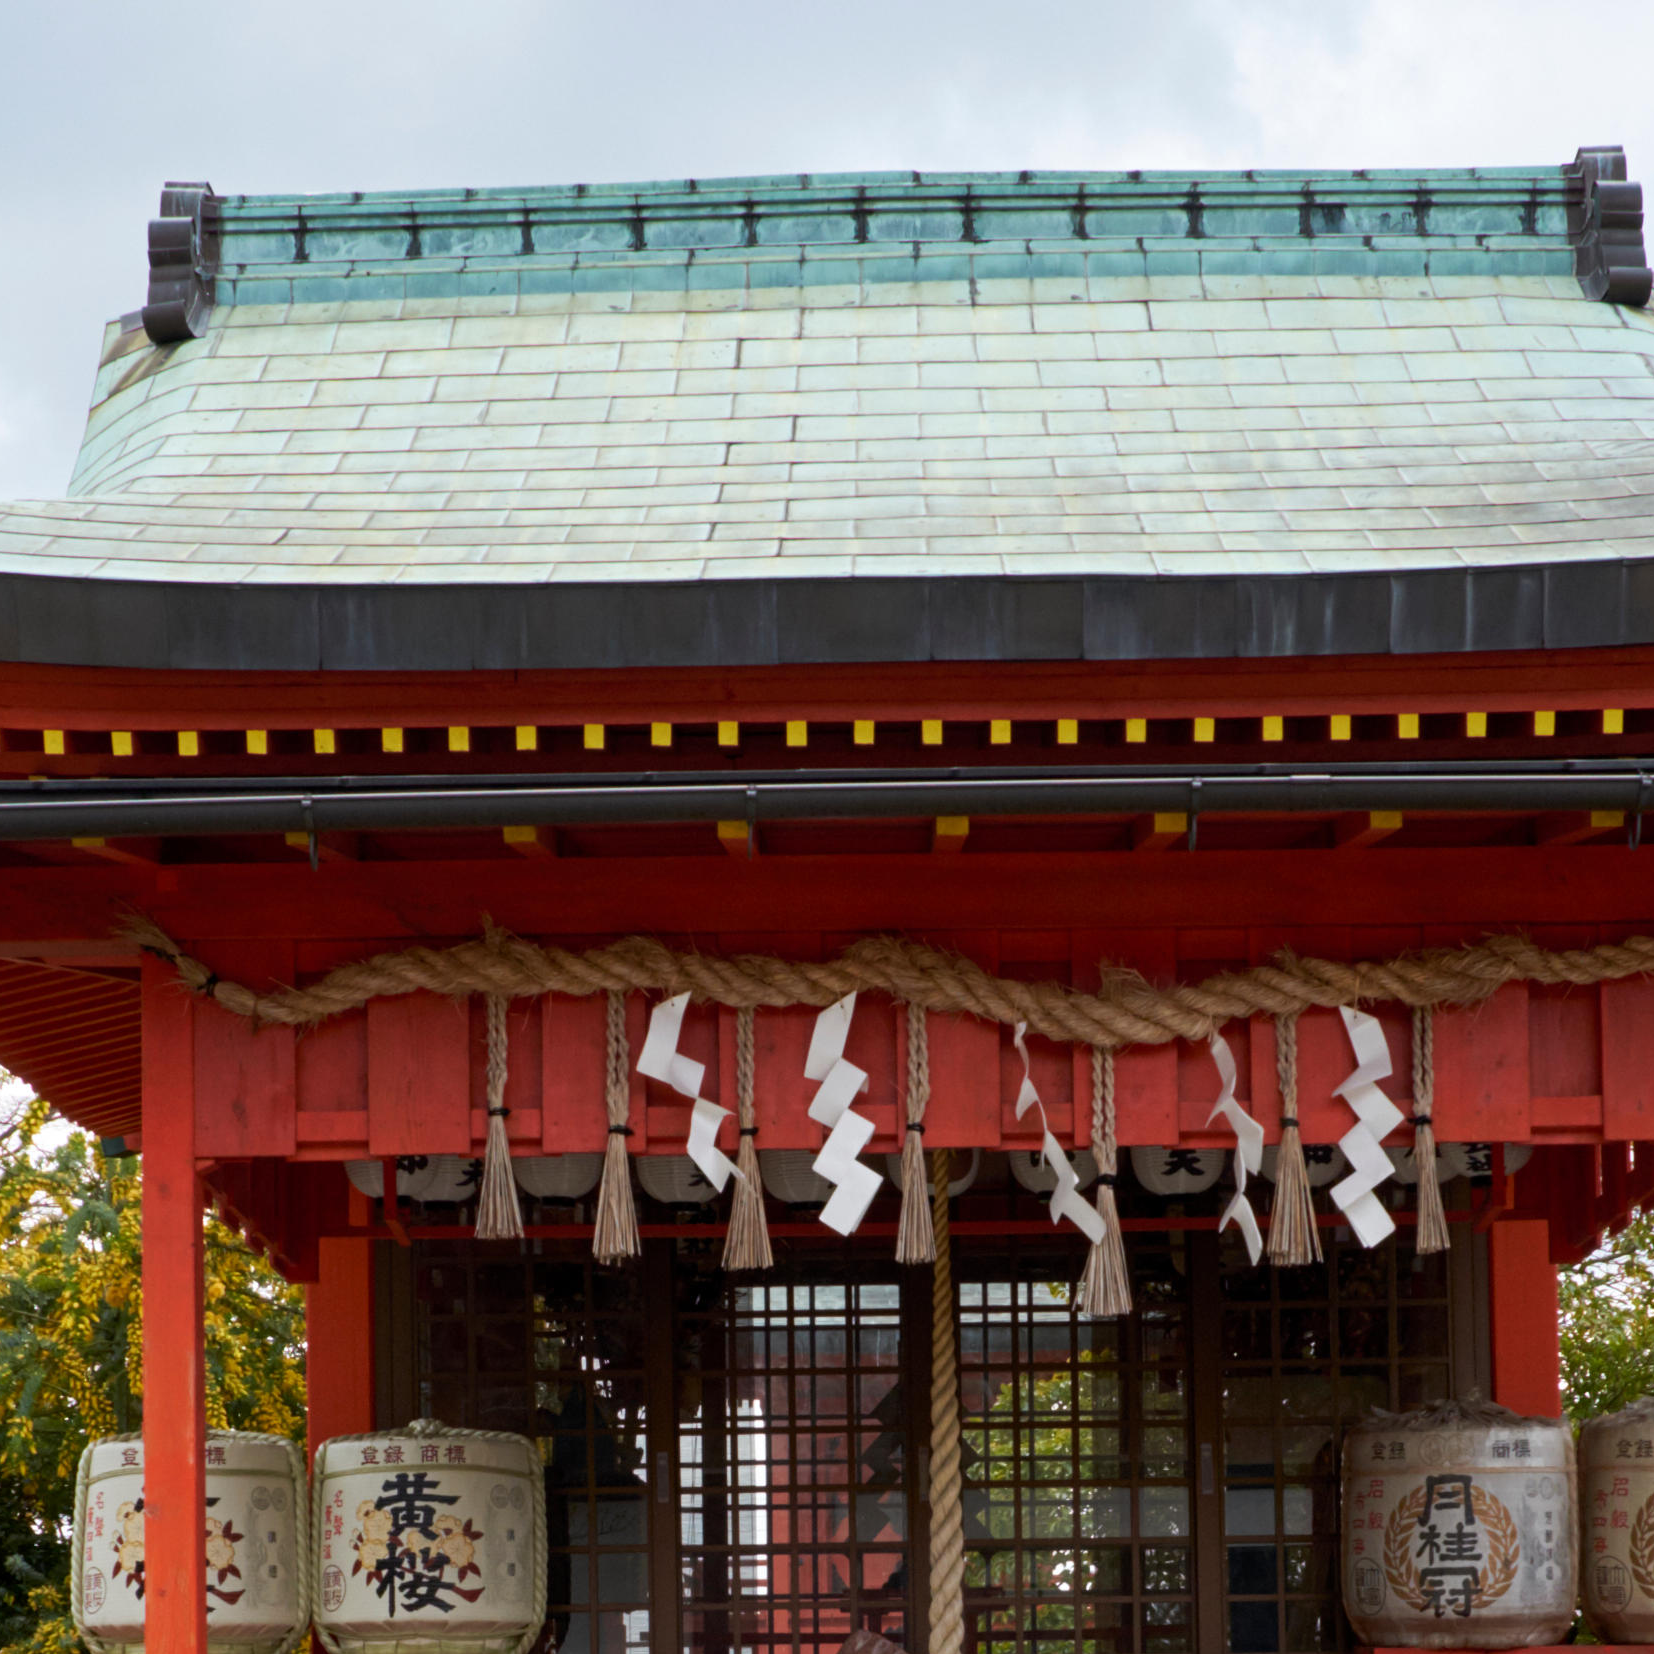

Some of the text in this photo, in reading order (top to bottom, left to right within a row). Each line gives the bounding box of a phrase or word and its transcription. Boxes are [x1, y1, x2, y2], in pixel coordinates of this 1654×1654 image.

[361, 1444, 466, 1465] 登録 商標
[1492, 1440, 1531, 1458] 商標
[374, 1472, 462, 1618] 黄桜
[1416, 1473, 1483, 1618] 月桂冠
